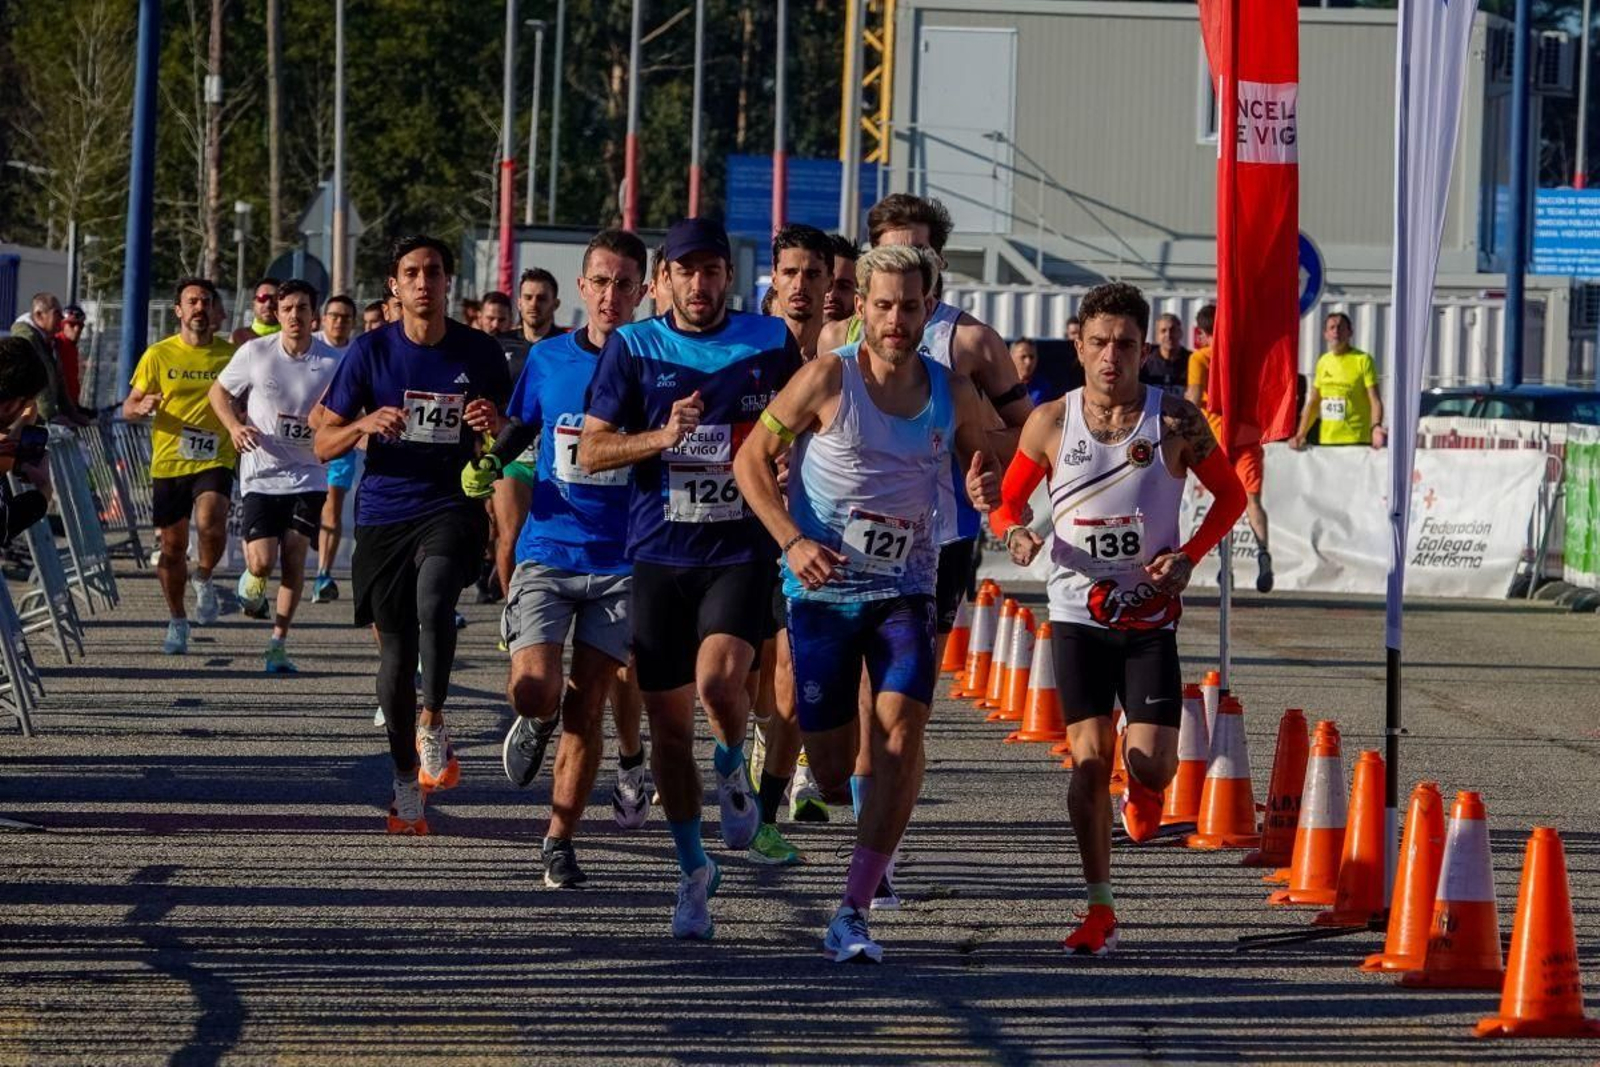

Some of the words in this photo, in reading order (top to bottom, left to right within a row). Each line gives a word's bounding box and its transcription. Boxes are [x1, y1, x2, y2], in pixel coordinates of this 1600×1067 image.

[1254, 125, 1296, 146] VIG
[415, 405, 460, 428] 145
[282, 422, 312, 439] 132
[189, 435, 215, 451] 114
[672, 445, 688, 456] DE
[689, 444, 718, 456] VIGO
[684, 478, 739, 504] 126
[1420, 516, 1493, 536] Federación
[863, 530, 908, 559] 121
[1085, 531, 1141, 559] 138
[1415, 535, 1473, 556] Galega
[1473, 540, 1488, 552] de
[1410, 552, 1484, 569] Atletismo
